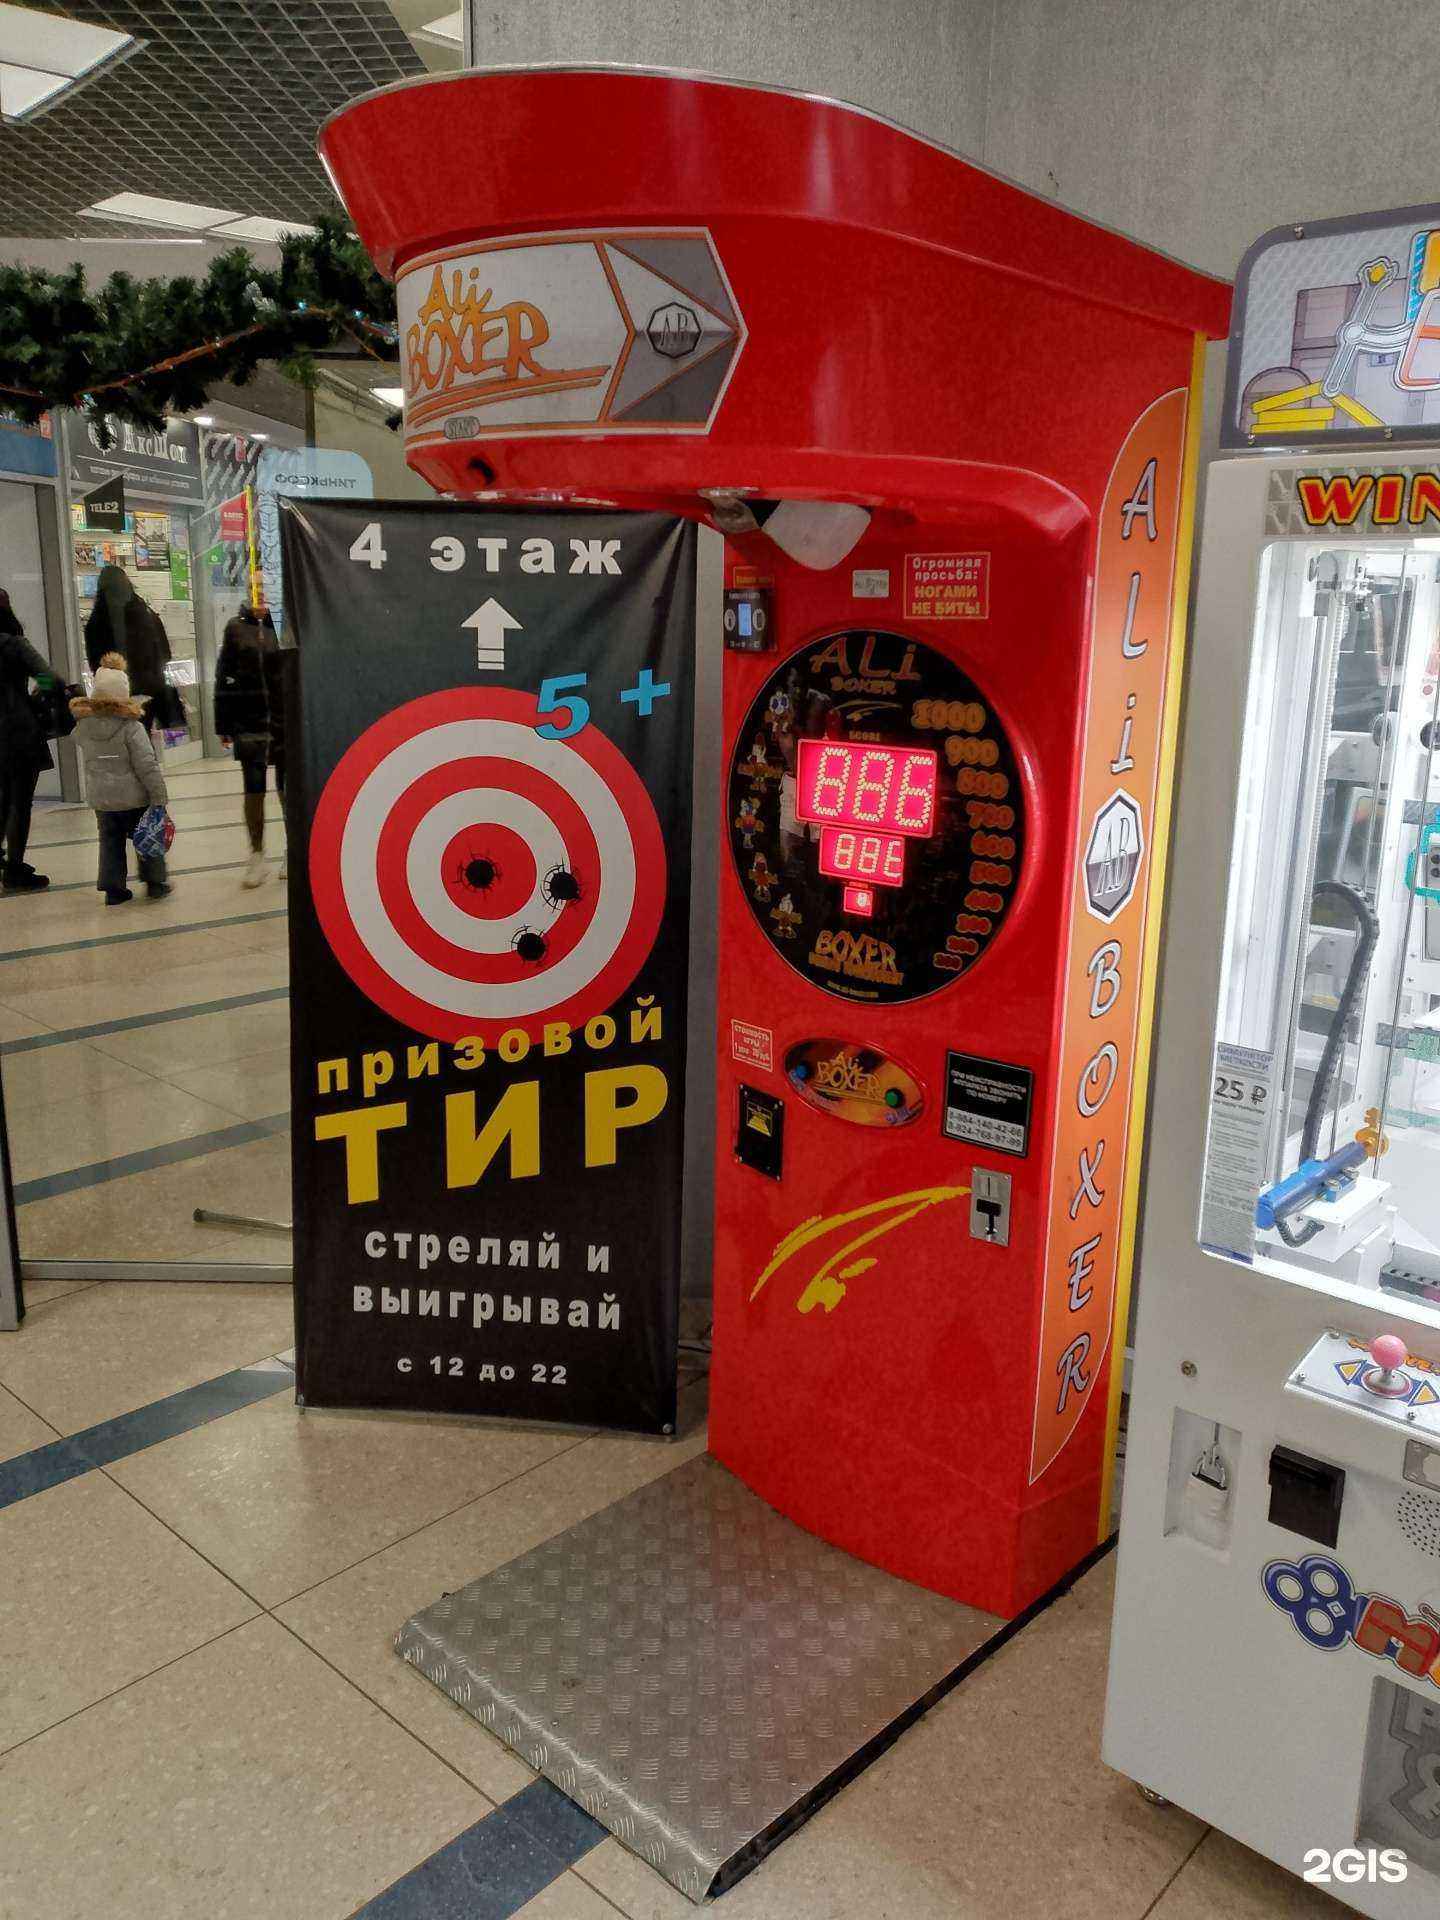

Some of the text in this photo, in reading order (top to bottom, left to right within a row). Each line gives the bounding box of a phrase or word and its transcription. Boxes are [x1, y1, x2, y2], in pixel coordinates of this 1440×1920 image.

[407, 300, 550, 398] BOXER
[89, 499, 119, 515] TELE2
[348, 522, 623, 576] 4 этаж
[912, 556, 982, 571] Огромная
[911, 601, 981, 616] НЕ БИТЬ!
[316, 994, 664, 1098] призовой
[1214, 1076, 1245, 1102] 25
[314, 1063, 669, 1206] ТИР
[1056, 939, 1122, 1415] BOXER
[364, 1231, 611, 1274] стреляй и
[352, 1284, 621, 1331] выигрывай
[397, 1355, 568, 1385] с 12 до 22
